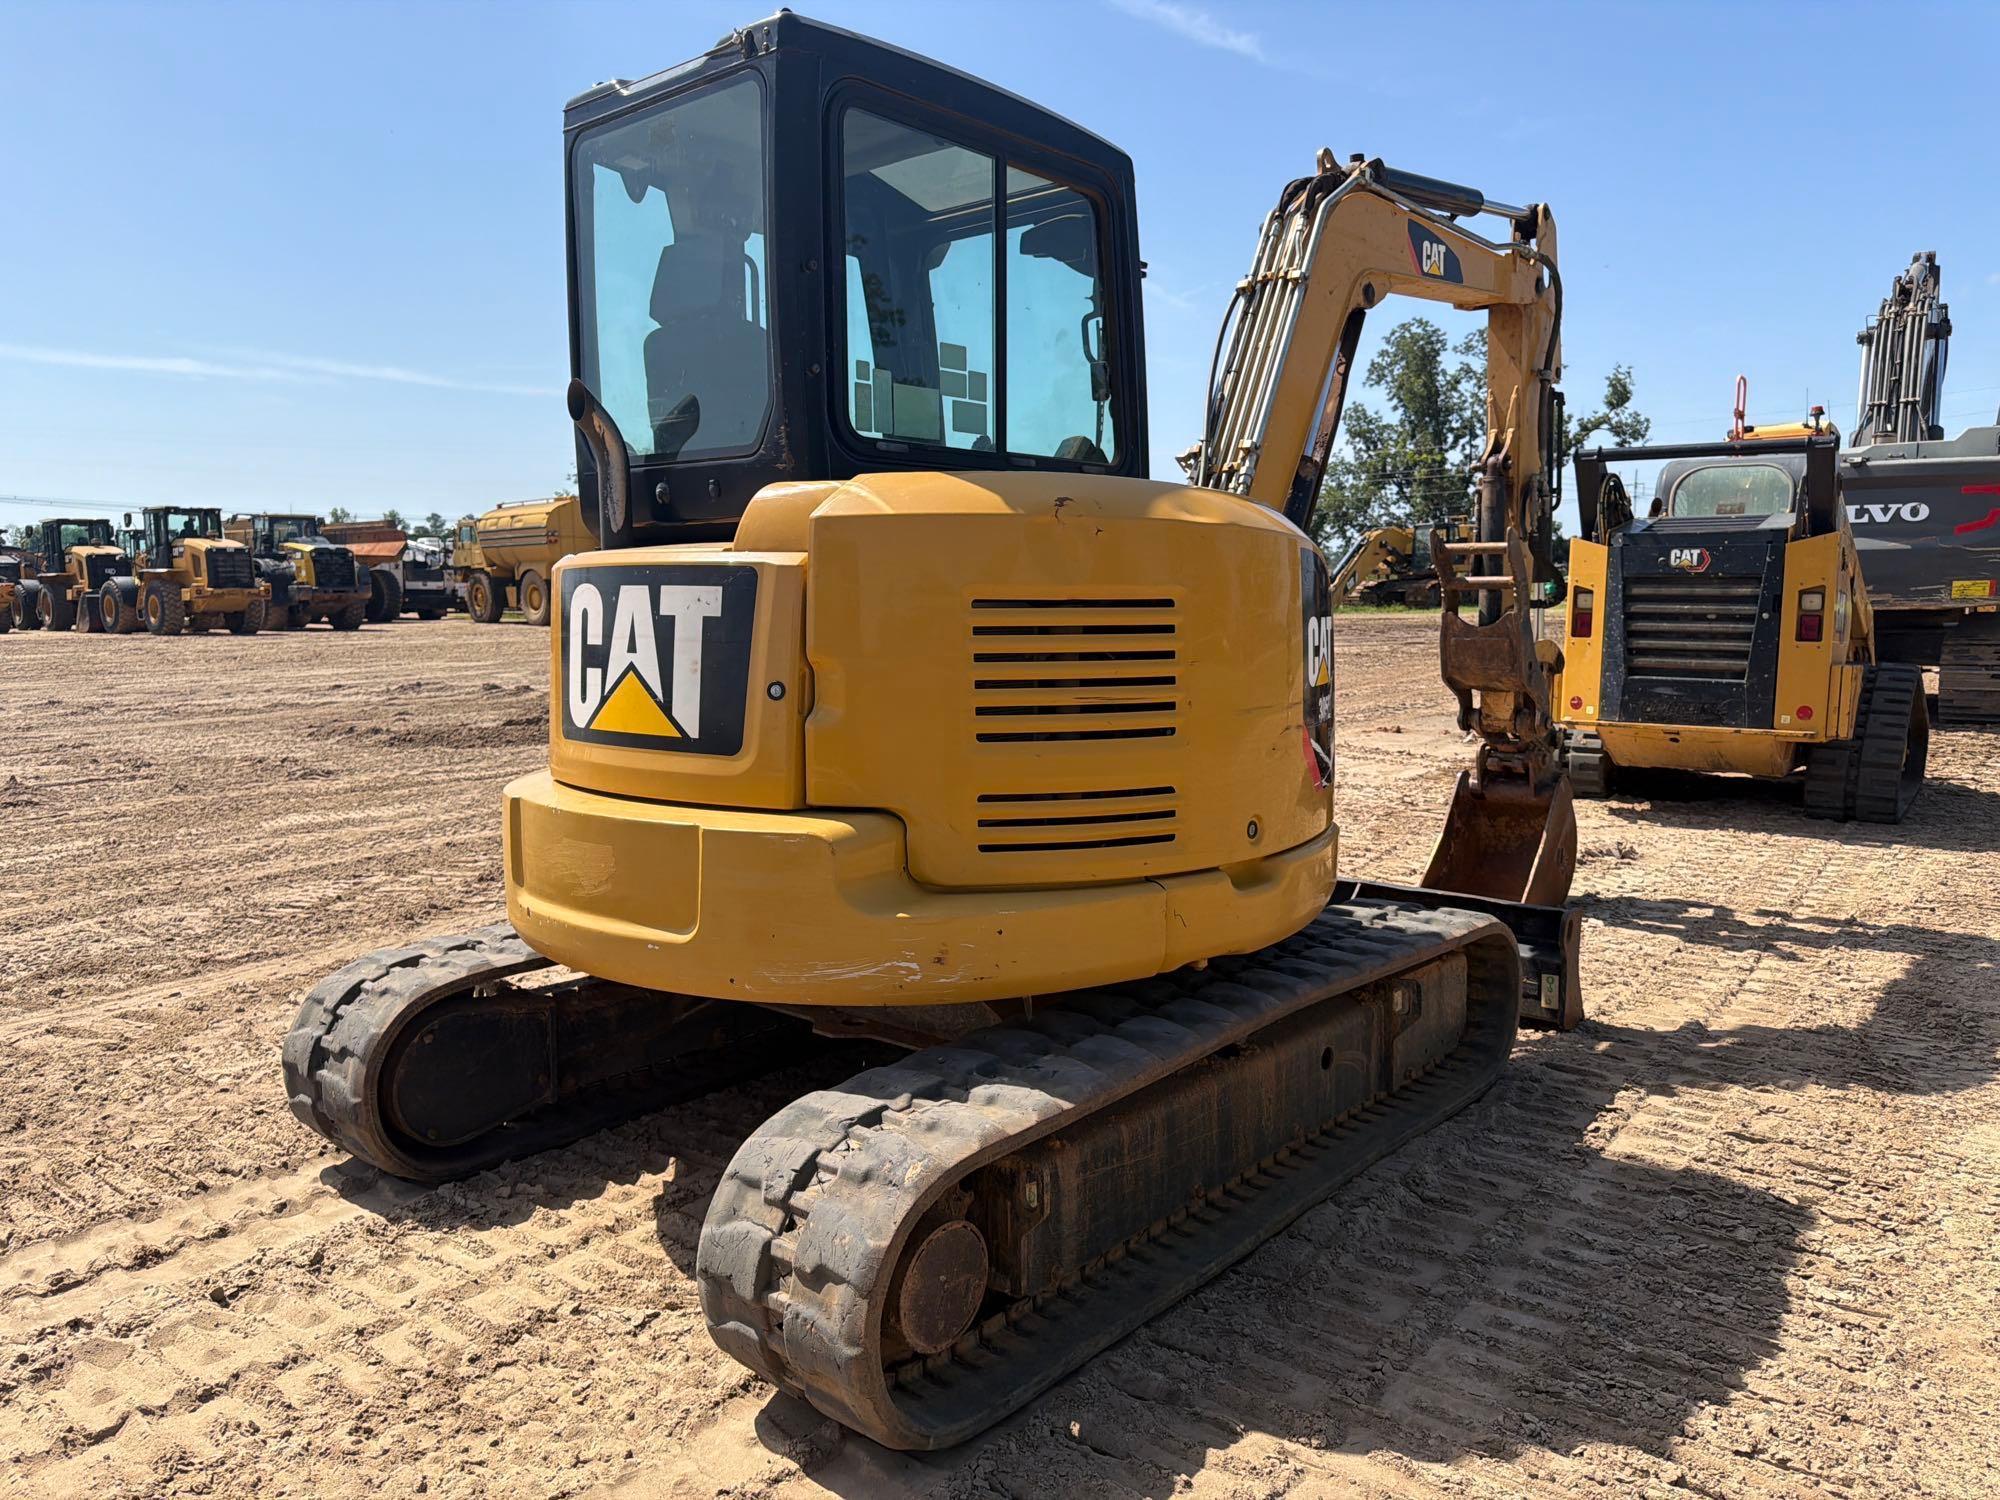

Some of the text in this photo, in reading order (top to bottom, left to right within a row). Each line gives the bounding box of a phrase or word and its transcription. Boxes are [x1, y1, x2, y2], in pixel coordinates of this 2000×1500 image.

[1422, 240, 1446, 276] CAT
[1846, 501, 1930, 523] LVO
[1670, 548, 1701, 567] CAT
[569, 582, 723, 740] CAT
[1308, 616, 1332, 688] CAT
